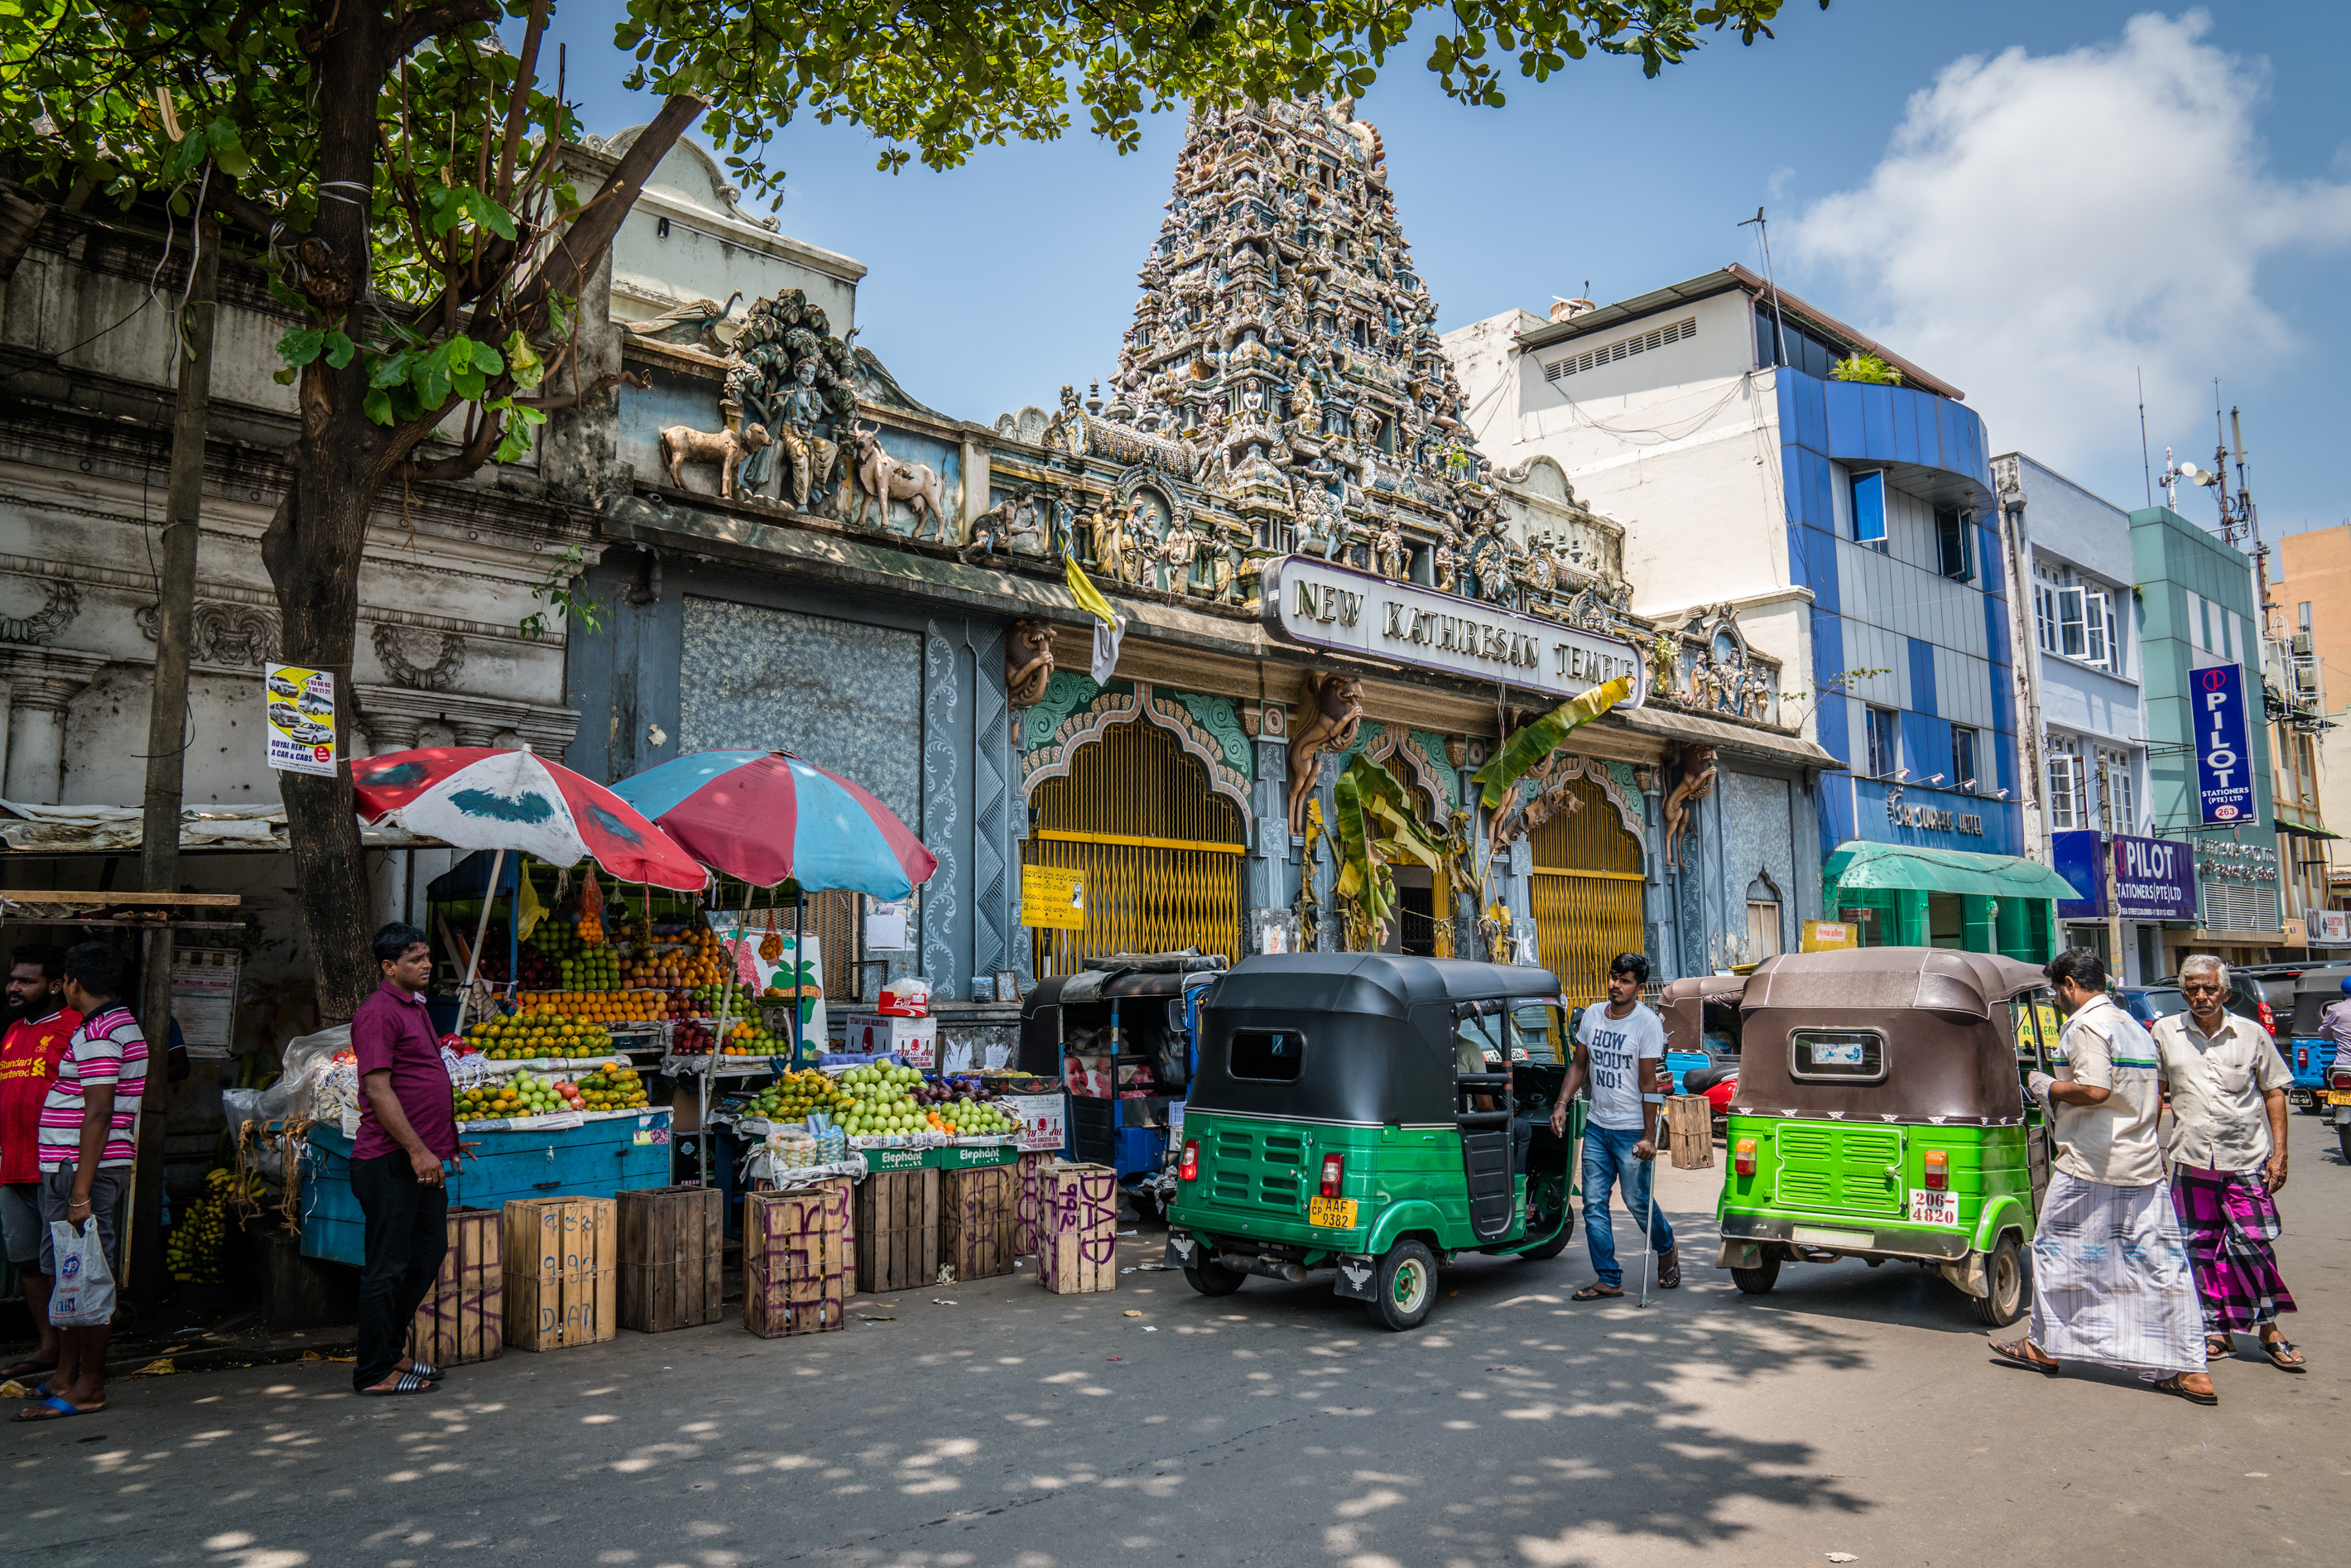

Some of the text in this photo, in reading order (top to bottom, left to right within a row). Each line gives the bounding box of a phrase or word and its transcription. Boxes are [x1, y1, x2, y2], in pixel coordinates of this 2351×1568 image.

[1293, 580, 1363, 627] NEW
[1382, 601, 1539, 668] KATHIRESAN
[272, 740, 306, 752] ROYAL RENT
[2206, 692, 2237, 788] PILOT
[276, 750, 289, 758] CAR
[296, 753, 313, 762] CABS
[2202, 787, 2249, 797] STATIONERS
[2209, 796, 2228, 805] (PTE)
[2218, 807, 2235, 816] 263
[1957, 812, 1983, 836] HOTEL
[2126, 841, 2173, 879] PILOT
[2328, 927, 2339, 936] TYRES
[893, 998, 911, 1008] Eva
[1591, 1028, 1627, 1051] HOW
[0, 1057, 32, 1070] Standard
[0, 1068, 30, 1080] hartered
[1596, 1068, 1622, 1089] NO!
[1325, 1199, 1349, 1213] AAF
[1915, 1192, 1955, 1208] 206-
[1311, 1205, 1323, 1215] CP
[1912, 1207, 1954, 1224] 4820
[1323, 1213, 1349, 1227] 9382
